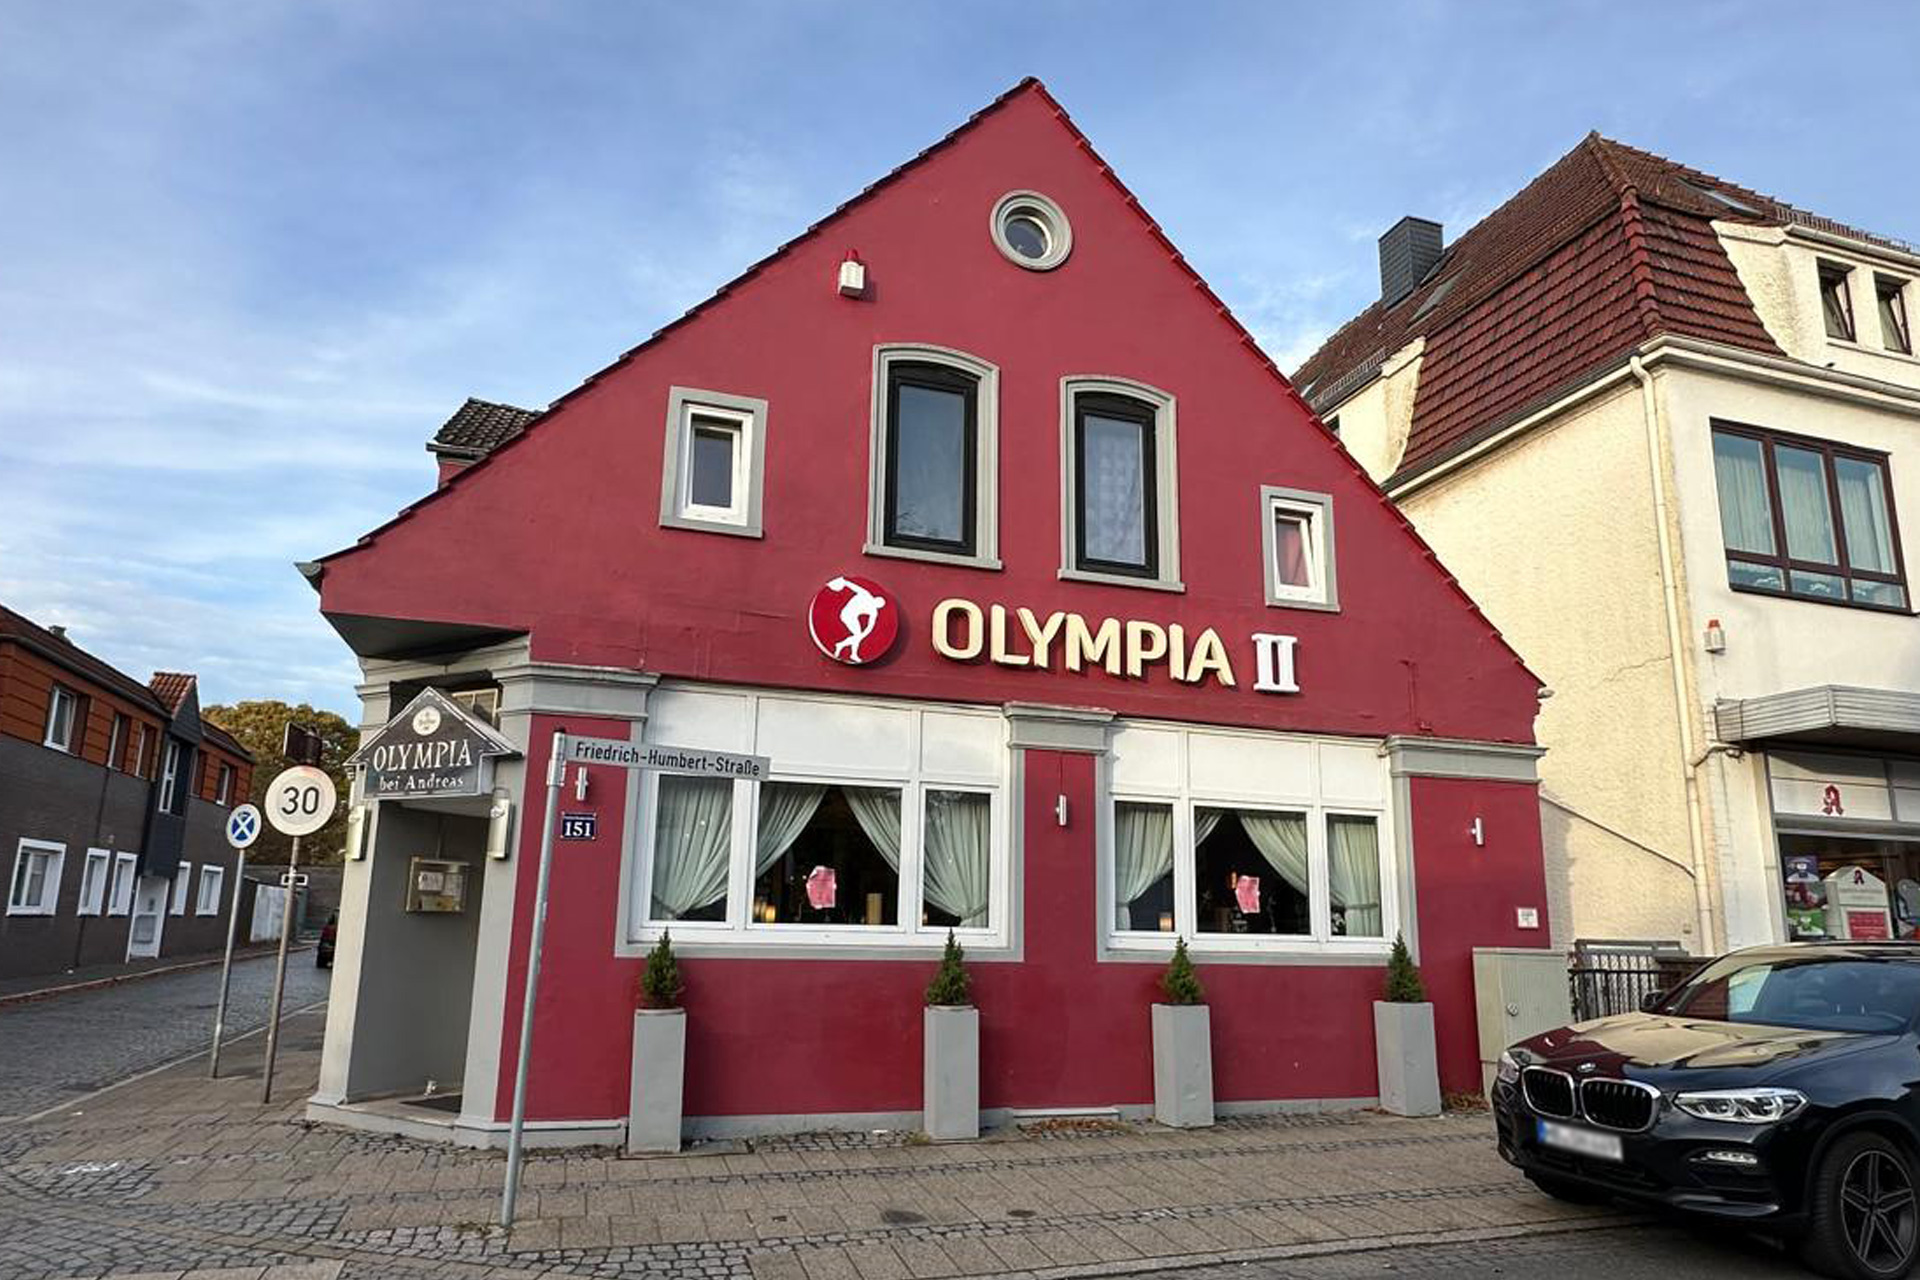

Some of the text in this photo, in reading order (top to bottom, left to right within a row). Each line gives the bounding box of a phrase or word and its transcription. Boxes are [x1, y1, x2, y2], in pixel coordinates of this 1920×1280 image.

[931, 598, 1300, 692] OLYMPIA II
[373, 738, 474, 772] OLYMPIA
[575, 741, 760, 776] Friedrich-Humbert-Straße
[379, 772, 465, 791] bei Andreas
[281, 786, 320, 815] 30
[564, 821, 591, 837] 151
